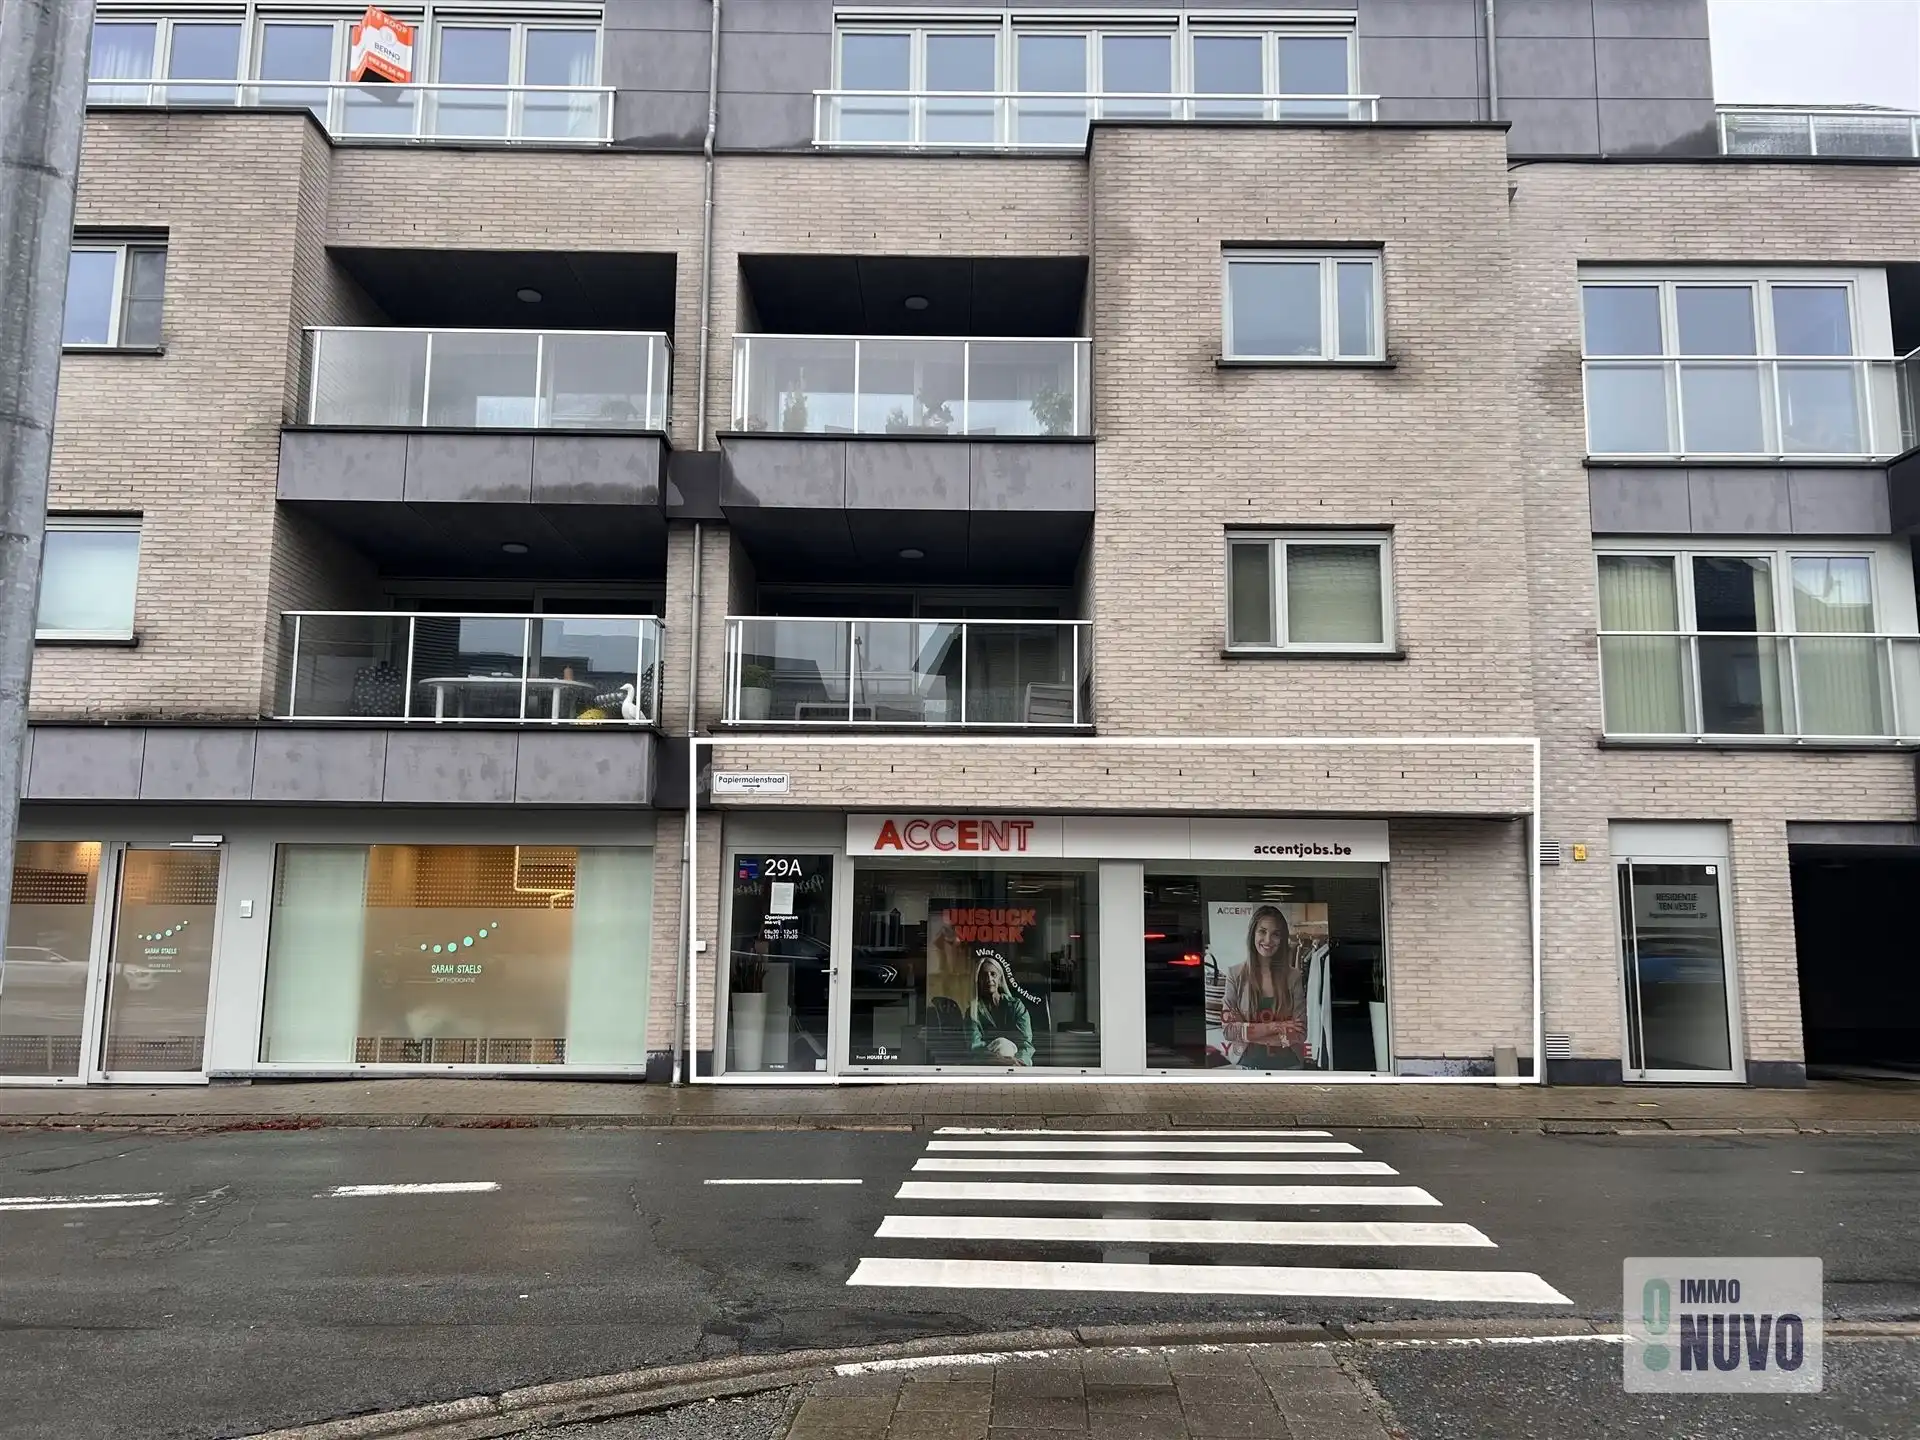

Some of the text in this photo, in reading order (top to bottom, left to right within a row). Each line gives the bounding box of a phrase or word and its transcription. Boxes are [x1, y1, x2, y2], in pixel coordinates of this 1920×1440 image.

[371, 9, 409, 34] TE KOOP
[374, 42, 401, 61] BERNO
[718, 776, 785, 784] Papiermolenstraat
[874, 819, 1034, 851] ACCENT
[1253, 842, 1352, 858] accentjobs.be
[764, 858, 802, 877] 29A
[1655, 893, 1698, 901] RESIDENTIE
[1216, 907, 1252, 915] ACCENT
[1658, 902, 1697, 911] TEN VESTE
[943, 908, 1037, 926] UNSUCK
[954, 925, 1024, 943] WORK
[431, 964, 482, 974] SARAH STAELS
[975, 948, 995, 956] Wat
[1009, 977, 1018, 988] so
[1017, 986, 1042, 1005] what?
